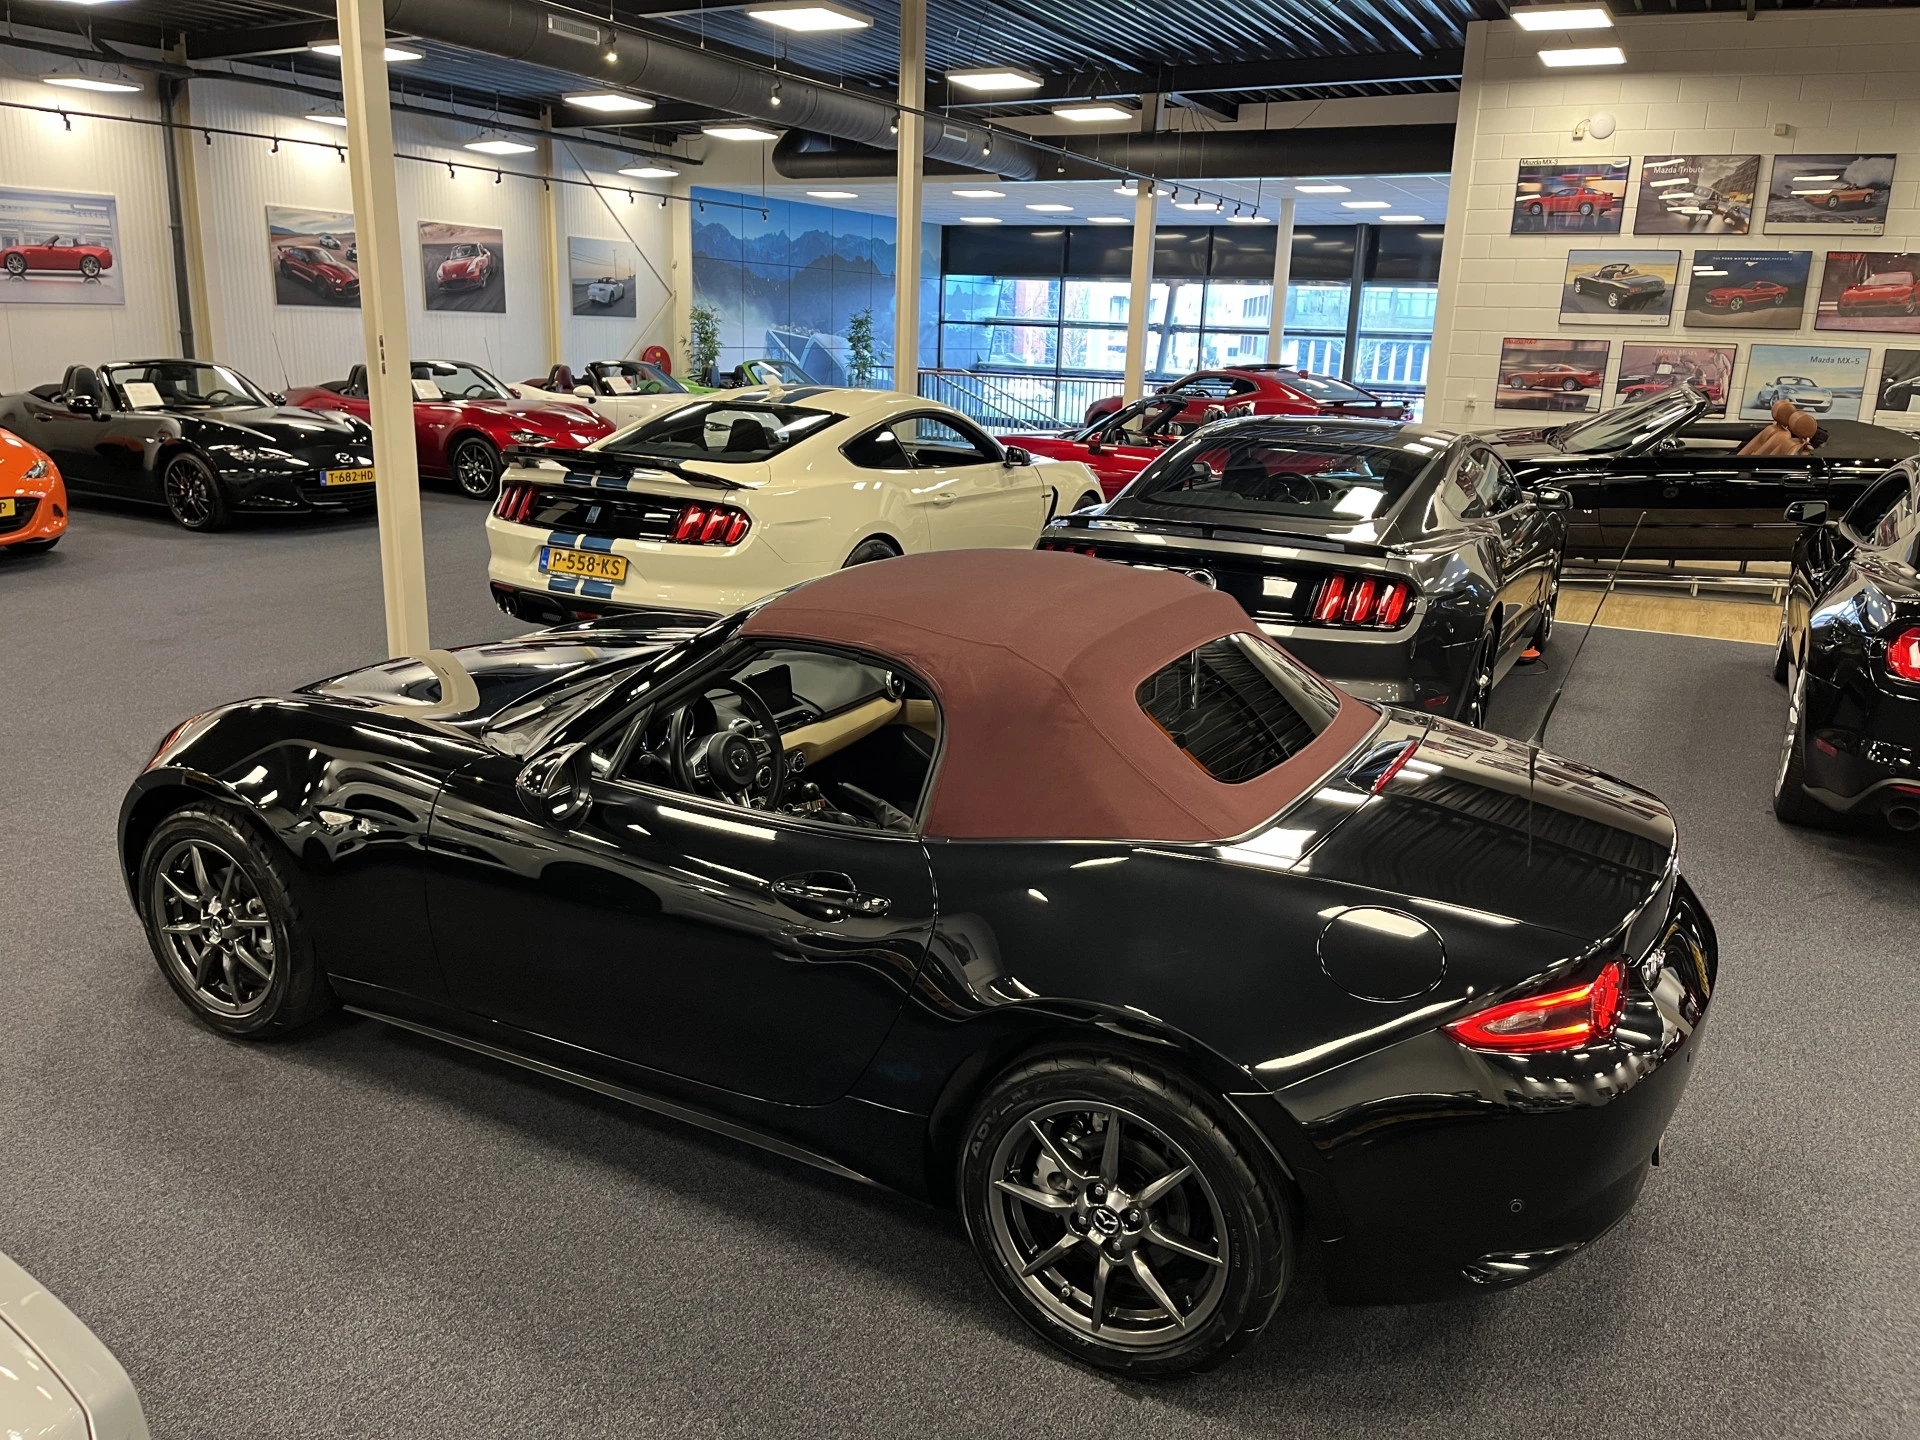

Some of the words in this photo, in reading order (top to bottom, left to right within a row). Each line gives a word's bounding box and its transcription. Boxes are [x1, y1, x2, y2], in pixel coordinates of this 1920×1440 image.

[1653, 166, 1677, 174] Mazda
[1679, 166, 1705, 174] Tribute
[1810, 356, 1835, 364] Mazda
[1837, 357, 1860, 365] MX-5
[329, 470, 373, 483] T-682-HD
[552, 551, 621, 576] P-558-KS
